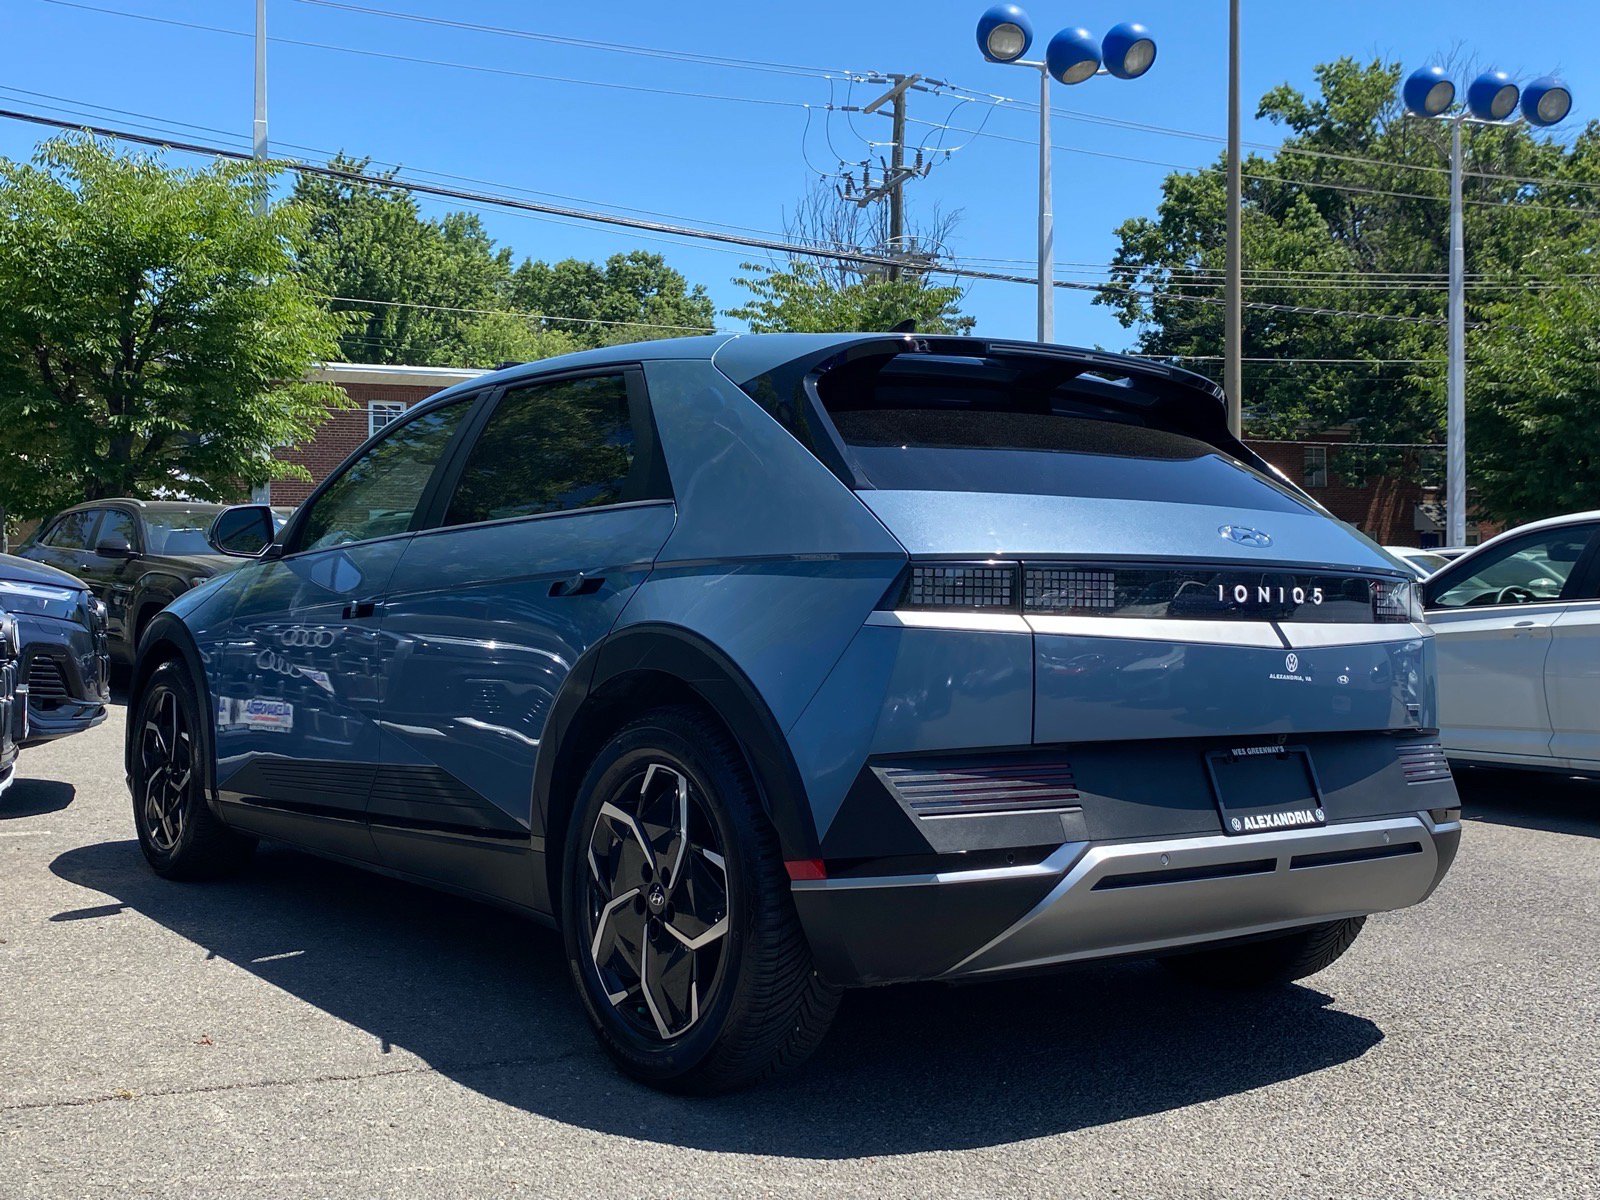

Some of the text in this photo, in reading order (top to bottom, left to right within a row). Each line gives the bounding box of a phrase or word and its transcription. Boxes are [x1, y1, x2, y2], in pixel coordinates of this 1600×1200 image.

[1232, 745, 1285, 756] WES GREENWAY'S
[1244, 810, 1315, 830] ALEXANDRIA
